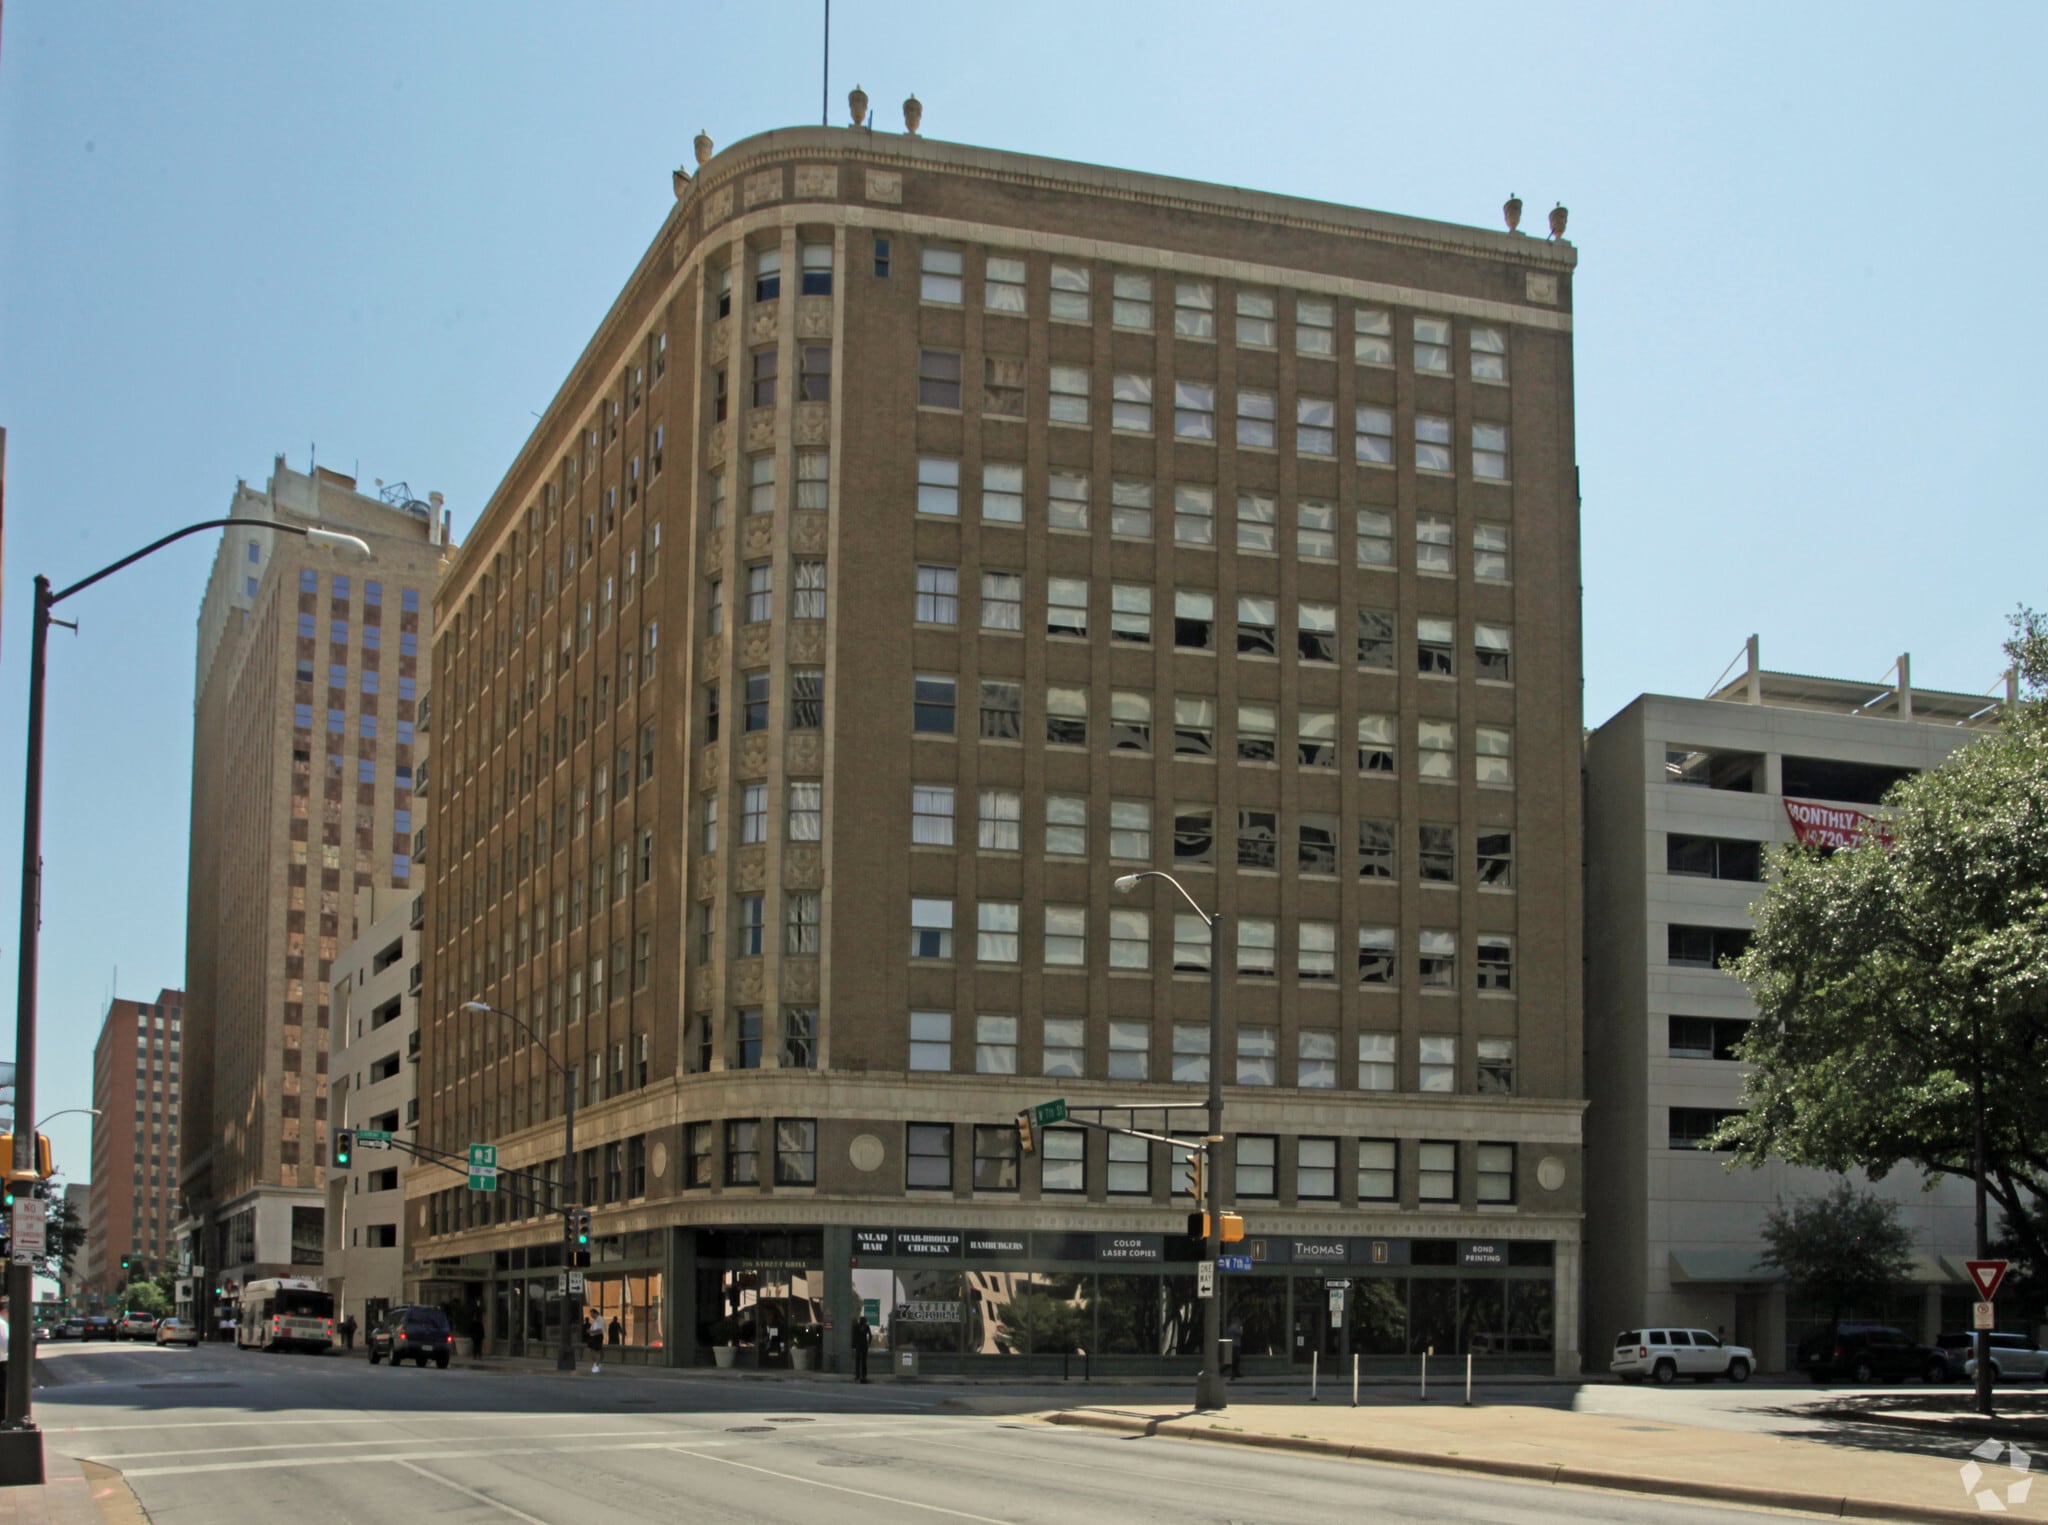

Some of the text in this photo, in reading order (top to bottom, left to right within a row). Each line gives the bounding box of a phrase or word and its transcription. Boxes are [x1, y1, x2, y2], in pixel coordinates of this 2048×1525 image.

[1787, 803, 1854, 830] MONTHLY
[24, 1203, 36, 1213] NO
[857, 1233, 888, 1242] SALAD
[898, 1234, 959, 1244] CHAR-BROILED
[863, 1243, 883, 1251] BAR
[908, 1244, 950, 1253] CHICKEN
[970, 1241, 1023, 1250] HAMBURGERS
[1295, 1242, 1344, 1255] THOMAS
[1102, 1249, 1157, 1257] LASER COPIES
[1465, 1254, 1500, 1262] PRINTING
[1200, 1263, 1213, 1273] ONE
[1200, 1273, 1212, 1283] WAY
